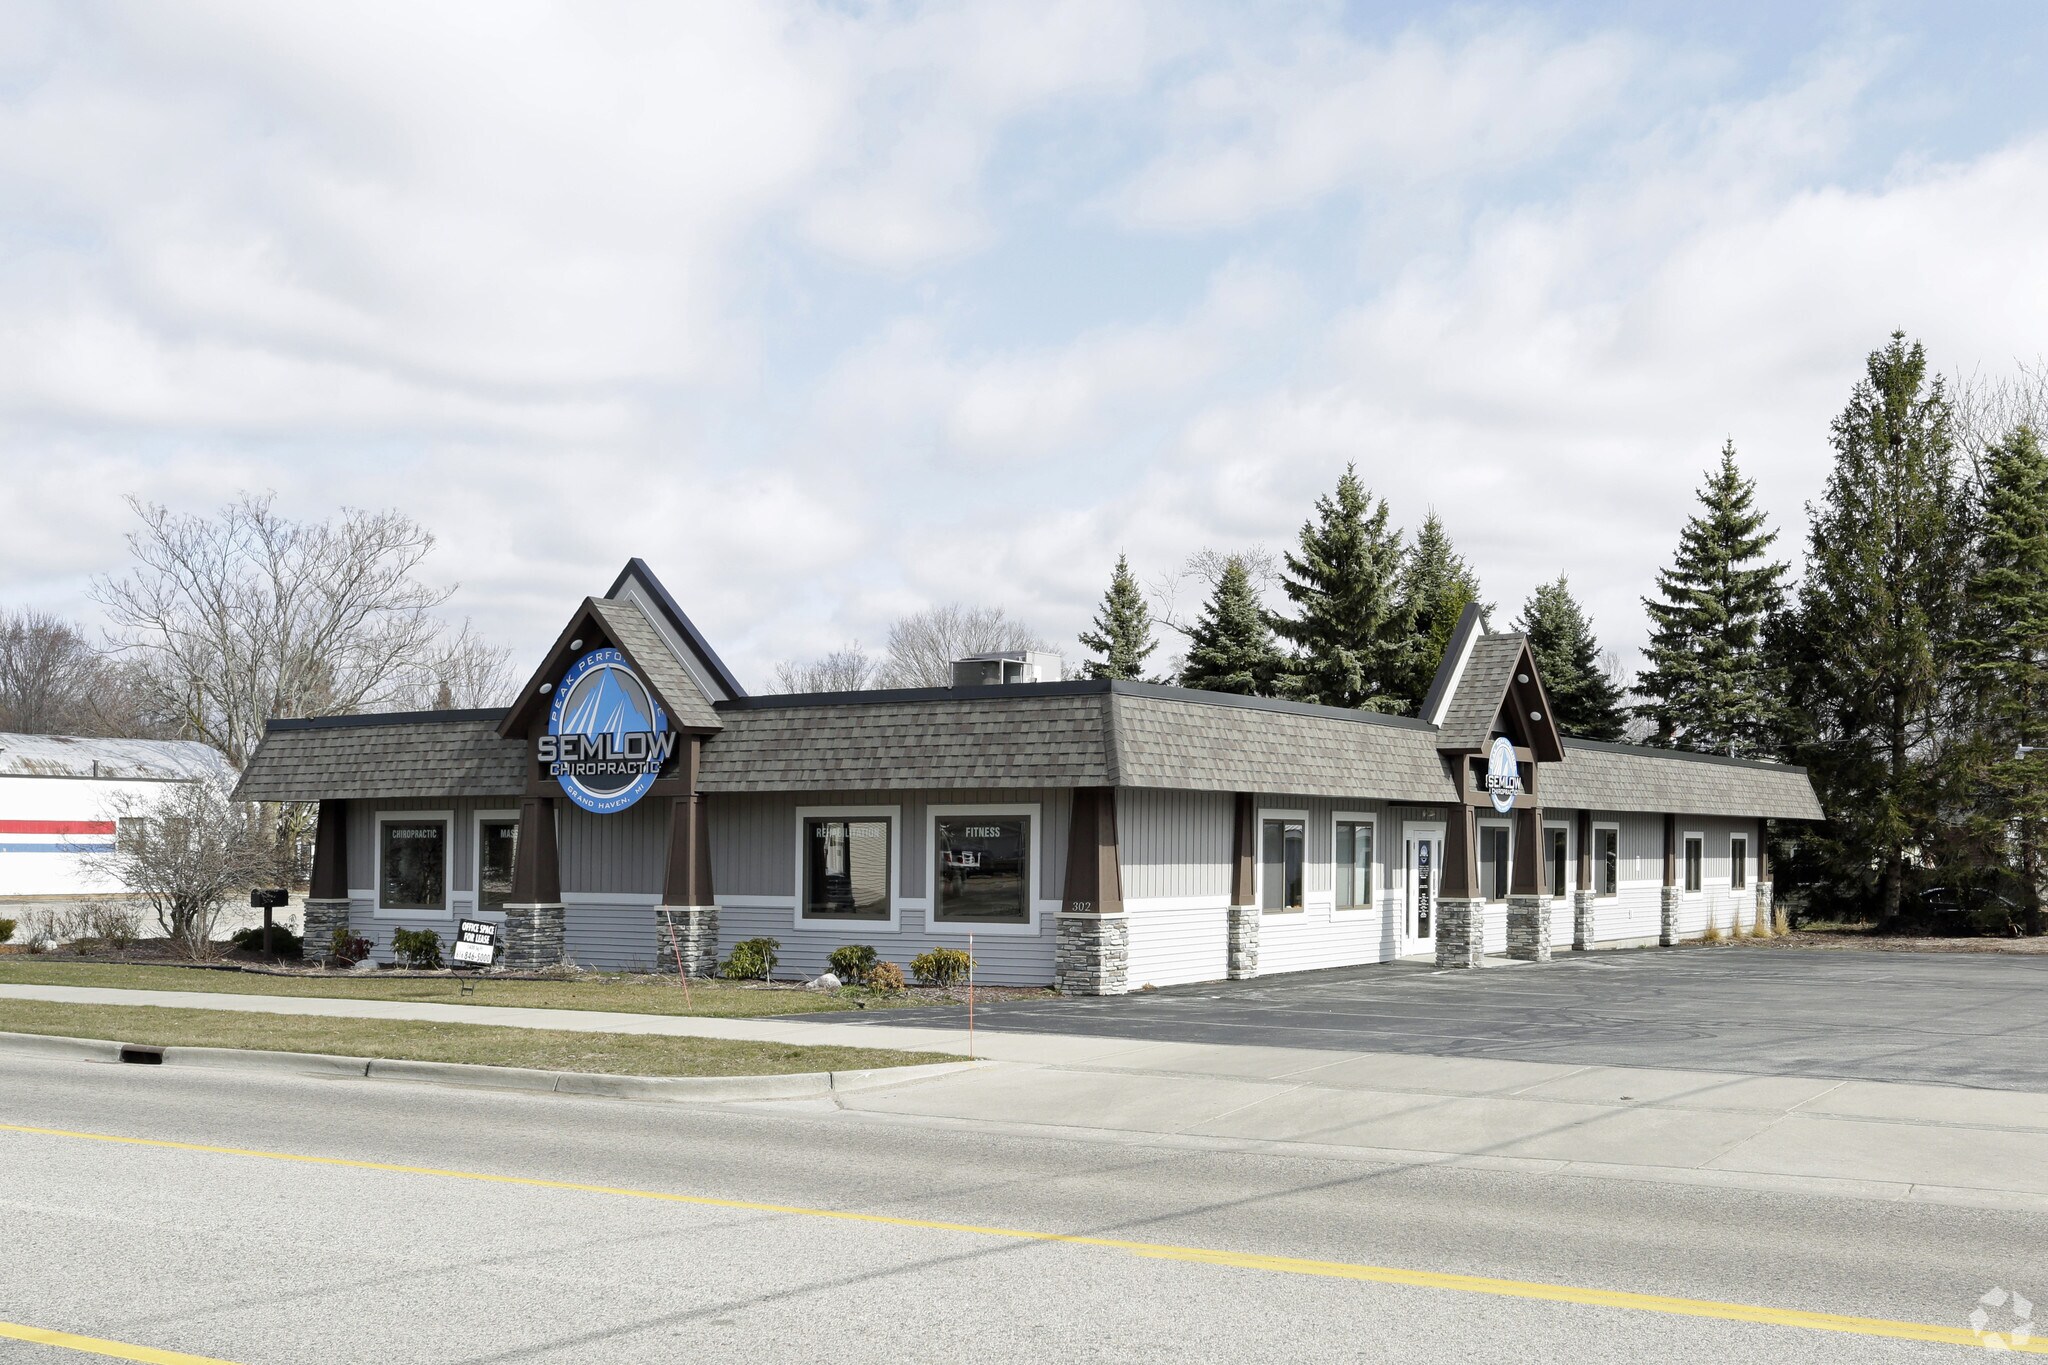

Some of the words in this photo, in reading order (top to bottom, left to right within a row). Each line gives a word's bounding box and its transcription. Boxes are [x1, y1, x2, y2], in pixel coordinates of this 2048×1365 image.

[551, 675, 575, 722] PEAK
[537, 731, 677, 762] SEMLOW
[550, 762, 662, 776] CHIROPRACTIC
[1488, 774, 1521, 788] SEMLOW
[567, 785, 594, 807] GRAND
[635, 783, 645, 795] MI
[392, 829, 437, 838] CHIROPRACTIC
[965, 826, 1000, 838] FITNESS
[1072, 901, 1091, 911] 302
[462, 921, 480, 933] OFFICE
[479, 924, 495, 935] SPACE
[463, 932, 475, 942] FOR
[475, 934, 490, 944] LEASE
